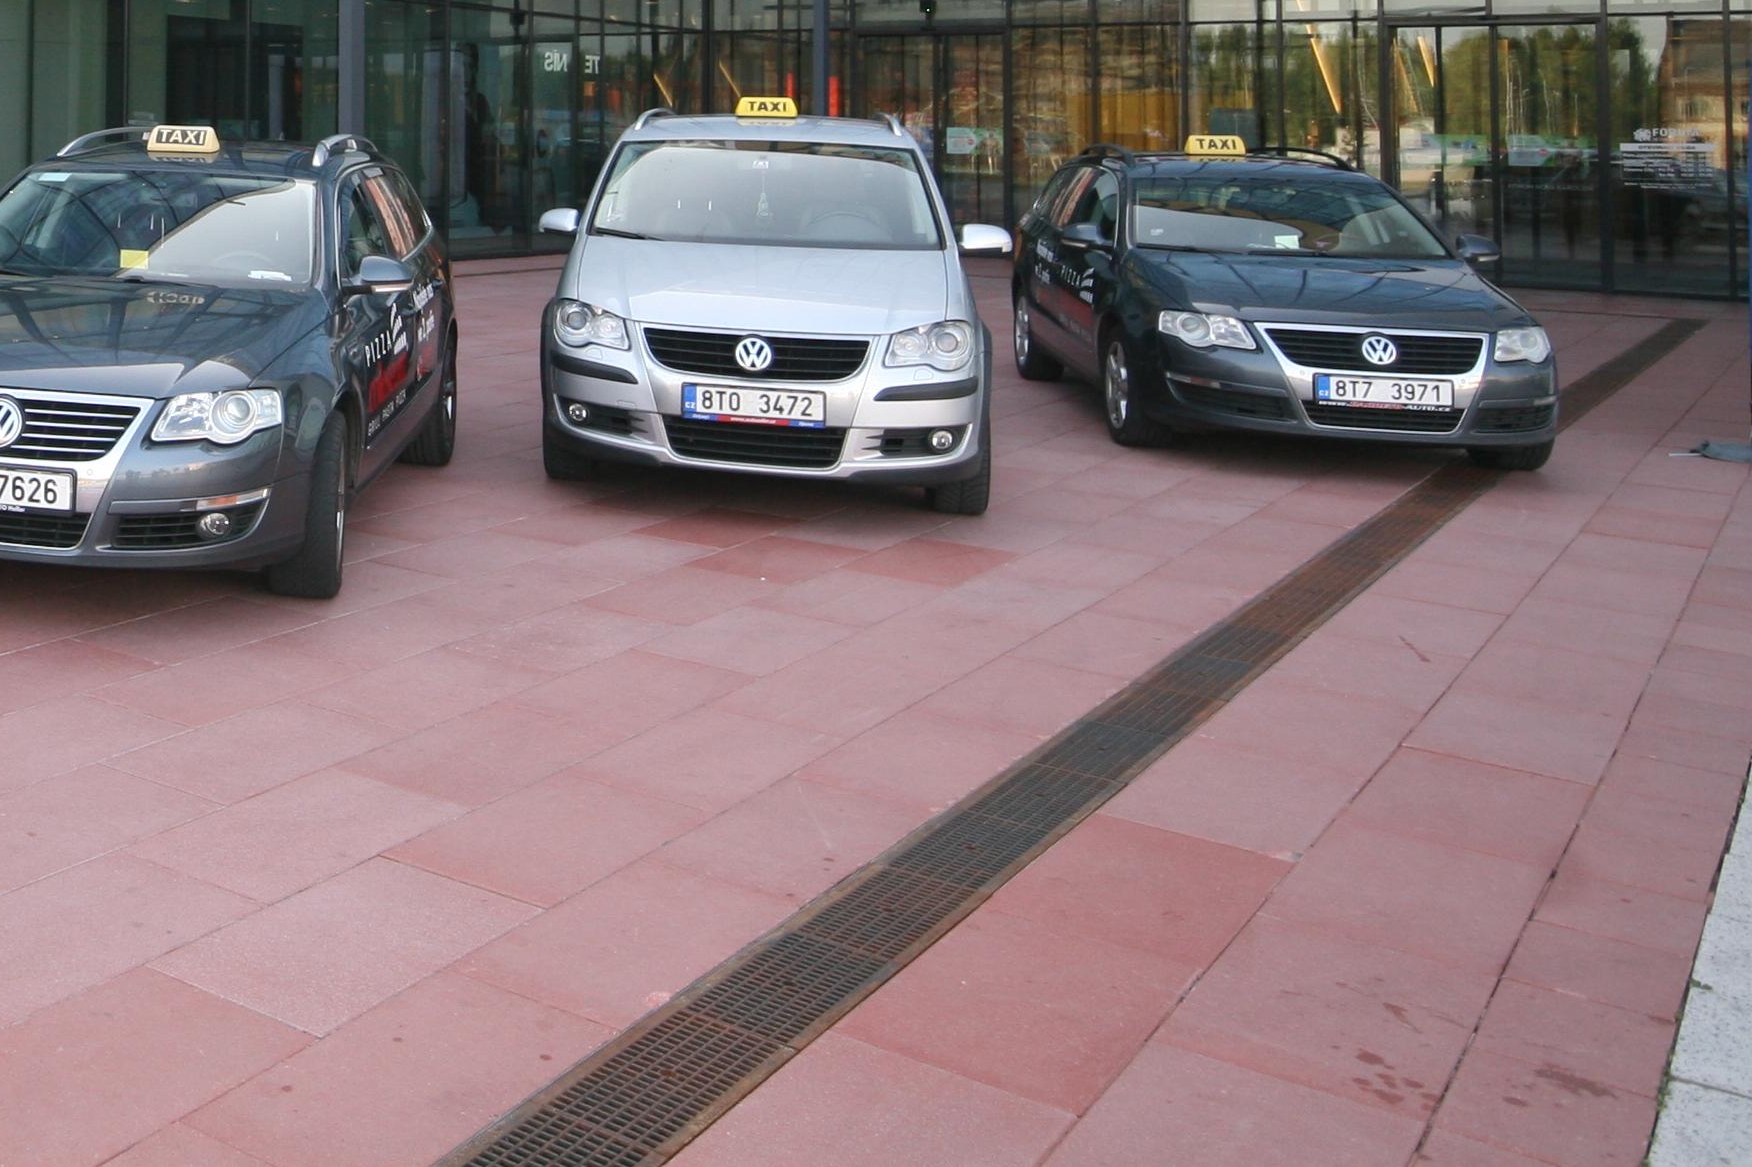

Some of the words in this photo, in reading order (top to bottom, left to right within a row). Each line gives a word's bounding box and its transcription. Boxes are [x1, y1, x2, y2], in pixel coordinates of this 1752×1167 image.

[747, 100, 788, 113] TAXI
[159, 129, 207, 145] TAXI
[1194, 135, 1238, 152] TAXI
[365, 330, 392, 367] PIZZA
[1335, 379, 1373, 399] 8T7
[1391, 382, 1441, 403] 3971
[759, 393, 813, 417] 3472
